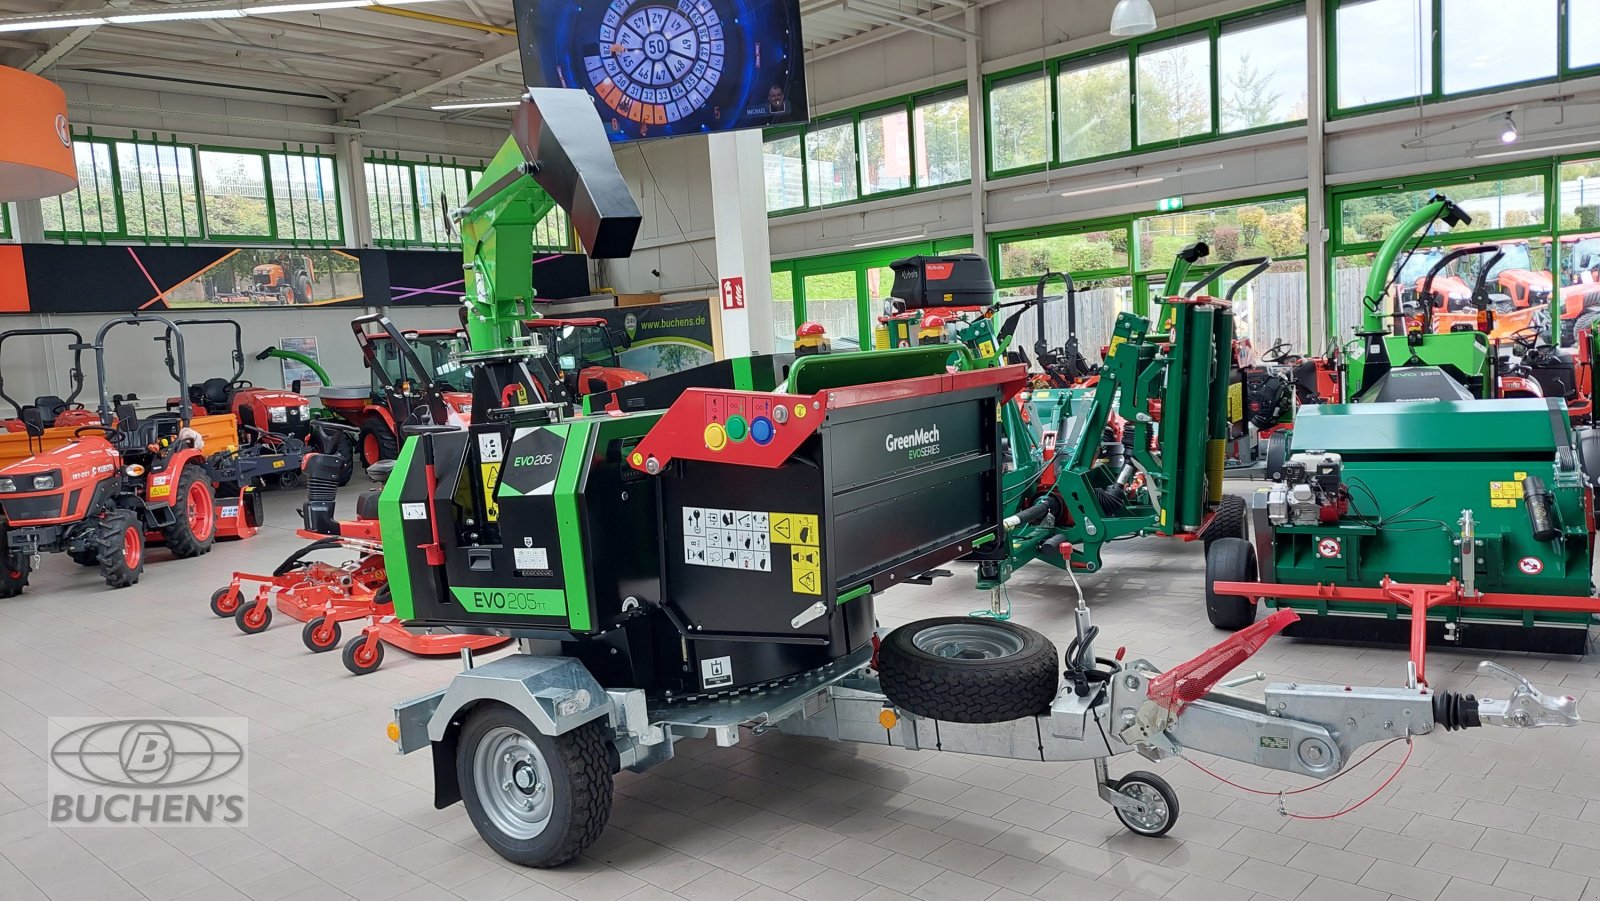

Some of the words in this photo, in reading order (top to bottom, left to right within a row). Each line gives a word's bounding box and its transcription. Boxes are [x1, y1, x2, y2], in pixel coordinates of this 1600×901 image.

[680, 0, 691, 11] 40
[607, 13, 616, 23] 26
[634, 16, 645, 29] 43
[652, 13, 663, 24] 42
[691, 12, 701, 23] 39
[671, 19, 681, 31] 41
[604, 29, 611, 42] 27
[700, 28, 708, 40] 38
[603, 45, 611, 55] 28
[649, 38, 665, 54] 50
[682, 39, 692, 51] 49
[700, 46, 709, 57] 37
[622, 55, 634, 67] 45
[607, 62, 617, 72] 29
[674, 61, 685, 73] 48
[698, 64, 705, 75] 36
[638, 68, 649, 80] 46
[656, 70, 666, 81] 47
[616, 77, 626, 87] 30
[685, 77, 696, 87] 35
[630, 86, 639, 96] 31
[644, 91, 654, 100] 32
[658, 91, 668, 100] 33
[672, 86, 684, 97] 34
[641, 316, 706, 330] www.buchens.de
[885, 423, 940, 452] GreenMech
[474, 591, 505, 609] EVO
